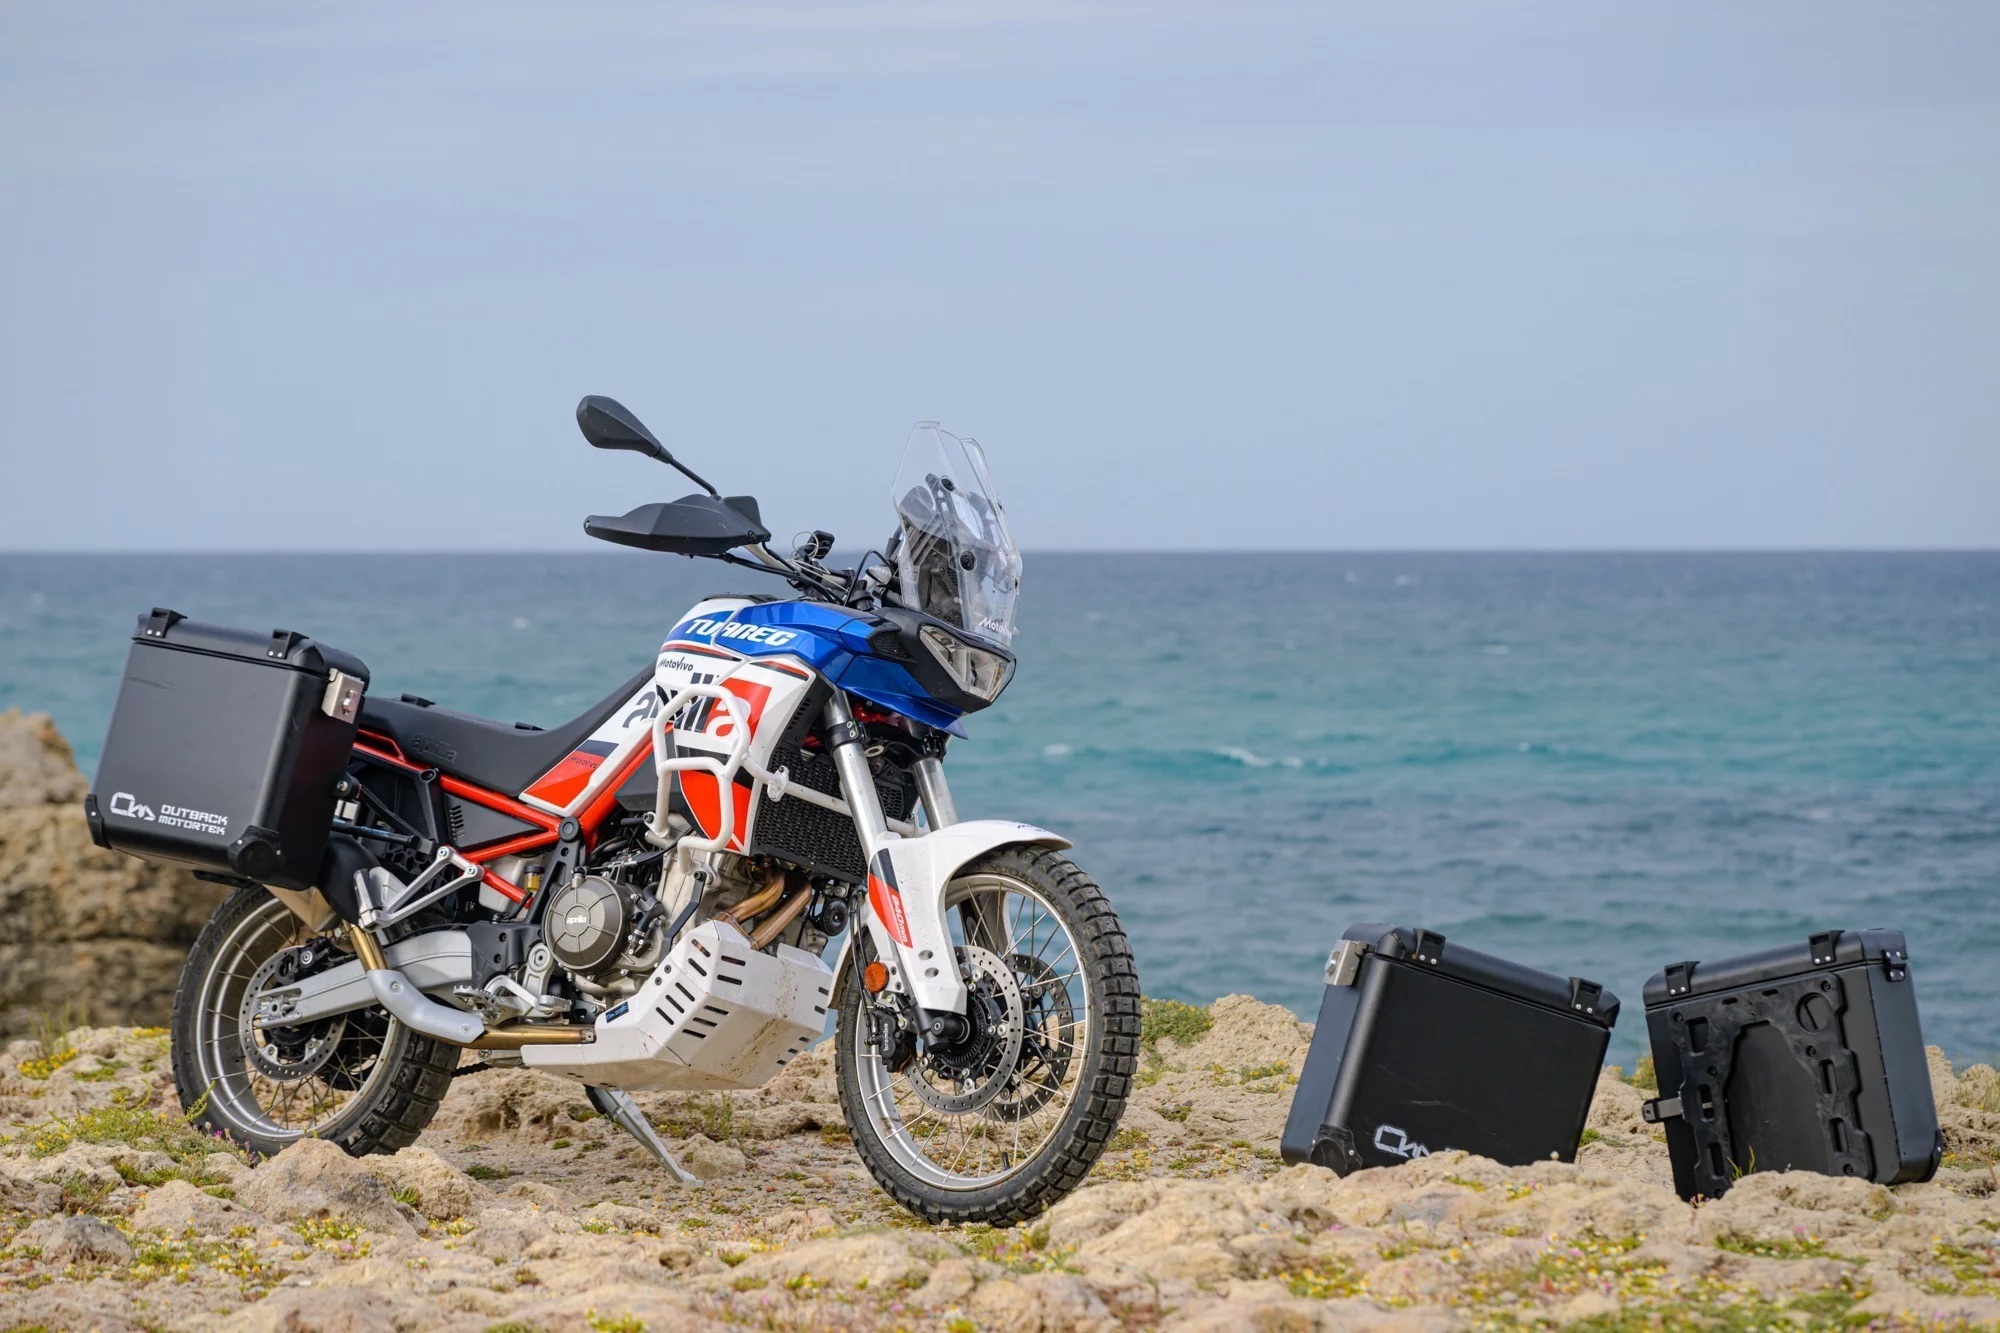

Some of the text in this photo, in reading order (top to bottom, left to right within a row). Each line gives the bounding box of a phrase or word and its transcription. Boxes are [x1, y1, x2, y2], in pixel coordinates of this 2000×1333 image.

[685, 619, 798, 647] TUAREG
[657, 656, 694, 672] MotoVivo
[622, 671, 752, 739] ailia
[158, 815, 226, 836] MOTORTEK
[160, 804, 228, 826] OUTBACK
